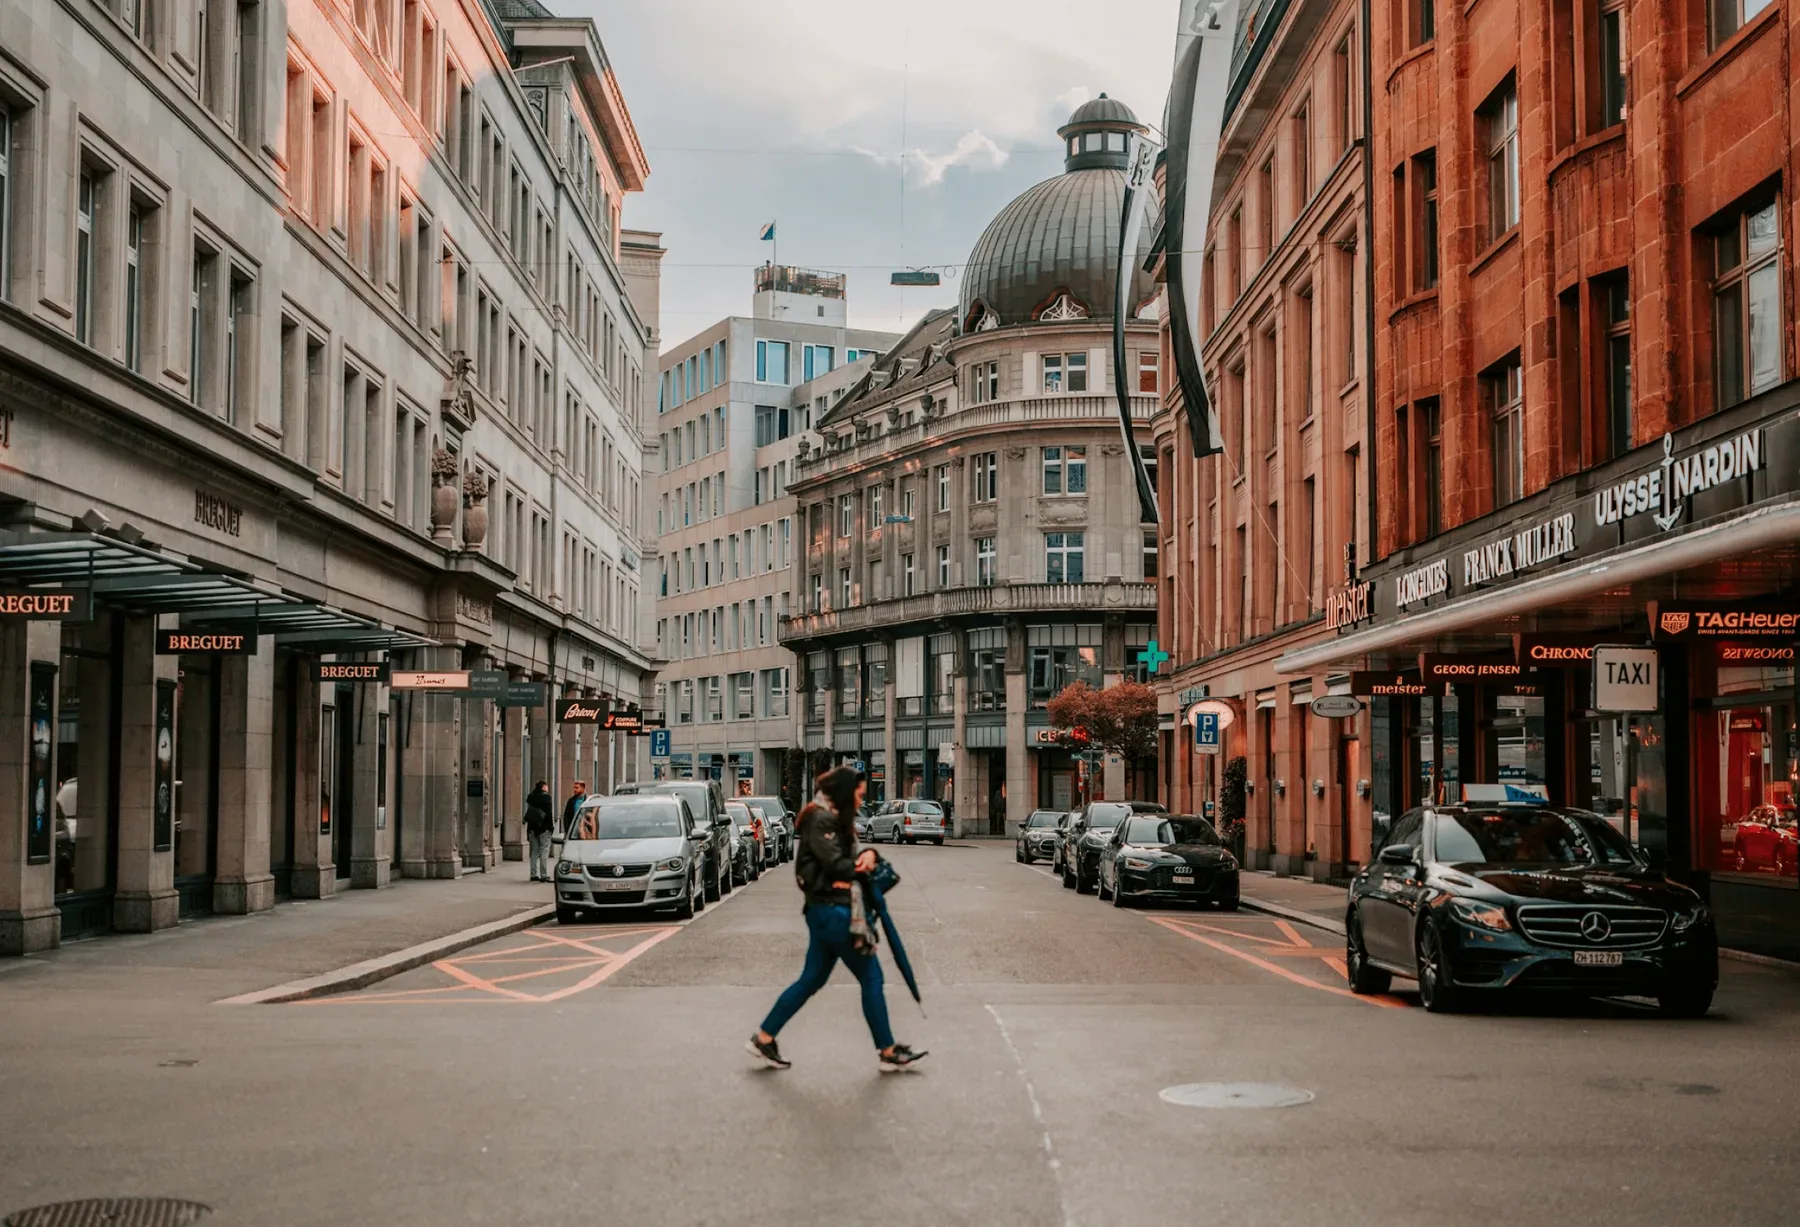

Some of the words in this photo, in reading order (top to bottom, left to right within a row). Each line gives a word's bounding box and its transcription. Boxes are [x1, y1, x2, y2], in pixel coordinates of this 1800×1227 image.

[1595, 470, 1661, 526] ULYSSE
[1674, 429, 1760, 500] NARDIN
[195, 489, 243, 537] BREGUET
[1464, 537, 1514, 586] FRANCK
[1515, 512, 1575, 570] MULLER
[1396, 558, 1448, 607] LONGINES
[1326, 580, 1370, 629] meister
[1665, 613, 1686, 621] TAG
[168, 635, 243, 649] BREGUET
[320, 666, 379, 678] BREGUET
[1433, 664, 1475, 675] GEORG
[1478, 664, 1521, 676] JENSEN
[1605, 661, 1650, 685] TAXI
[1372, 684, 1426, 694] meister
[1203, 715, 1213, 731] P
[656, 732, 665, 745] P
[471, 760, 480, 768] 11
